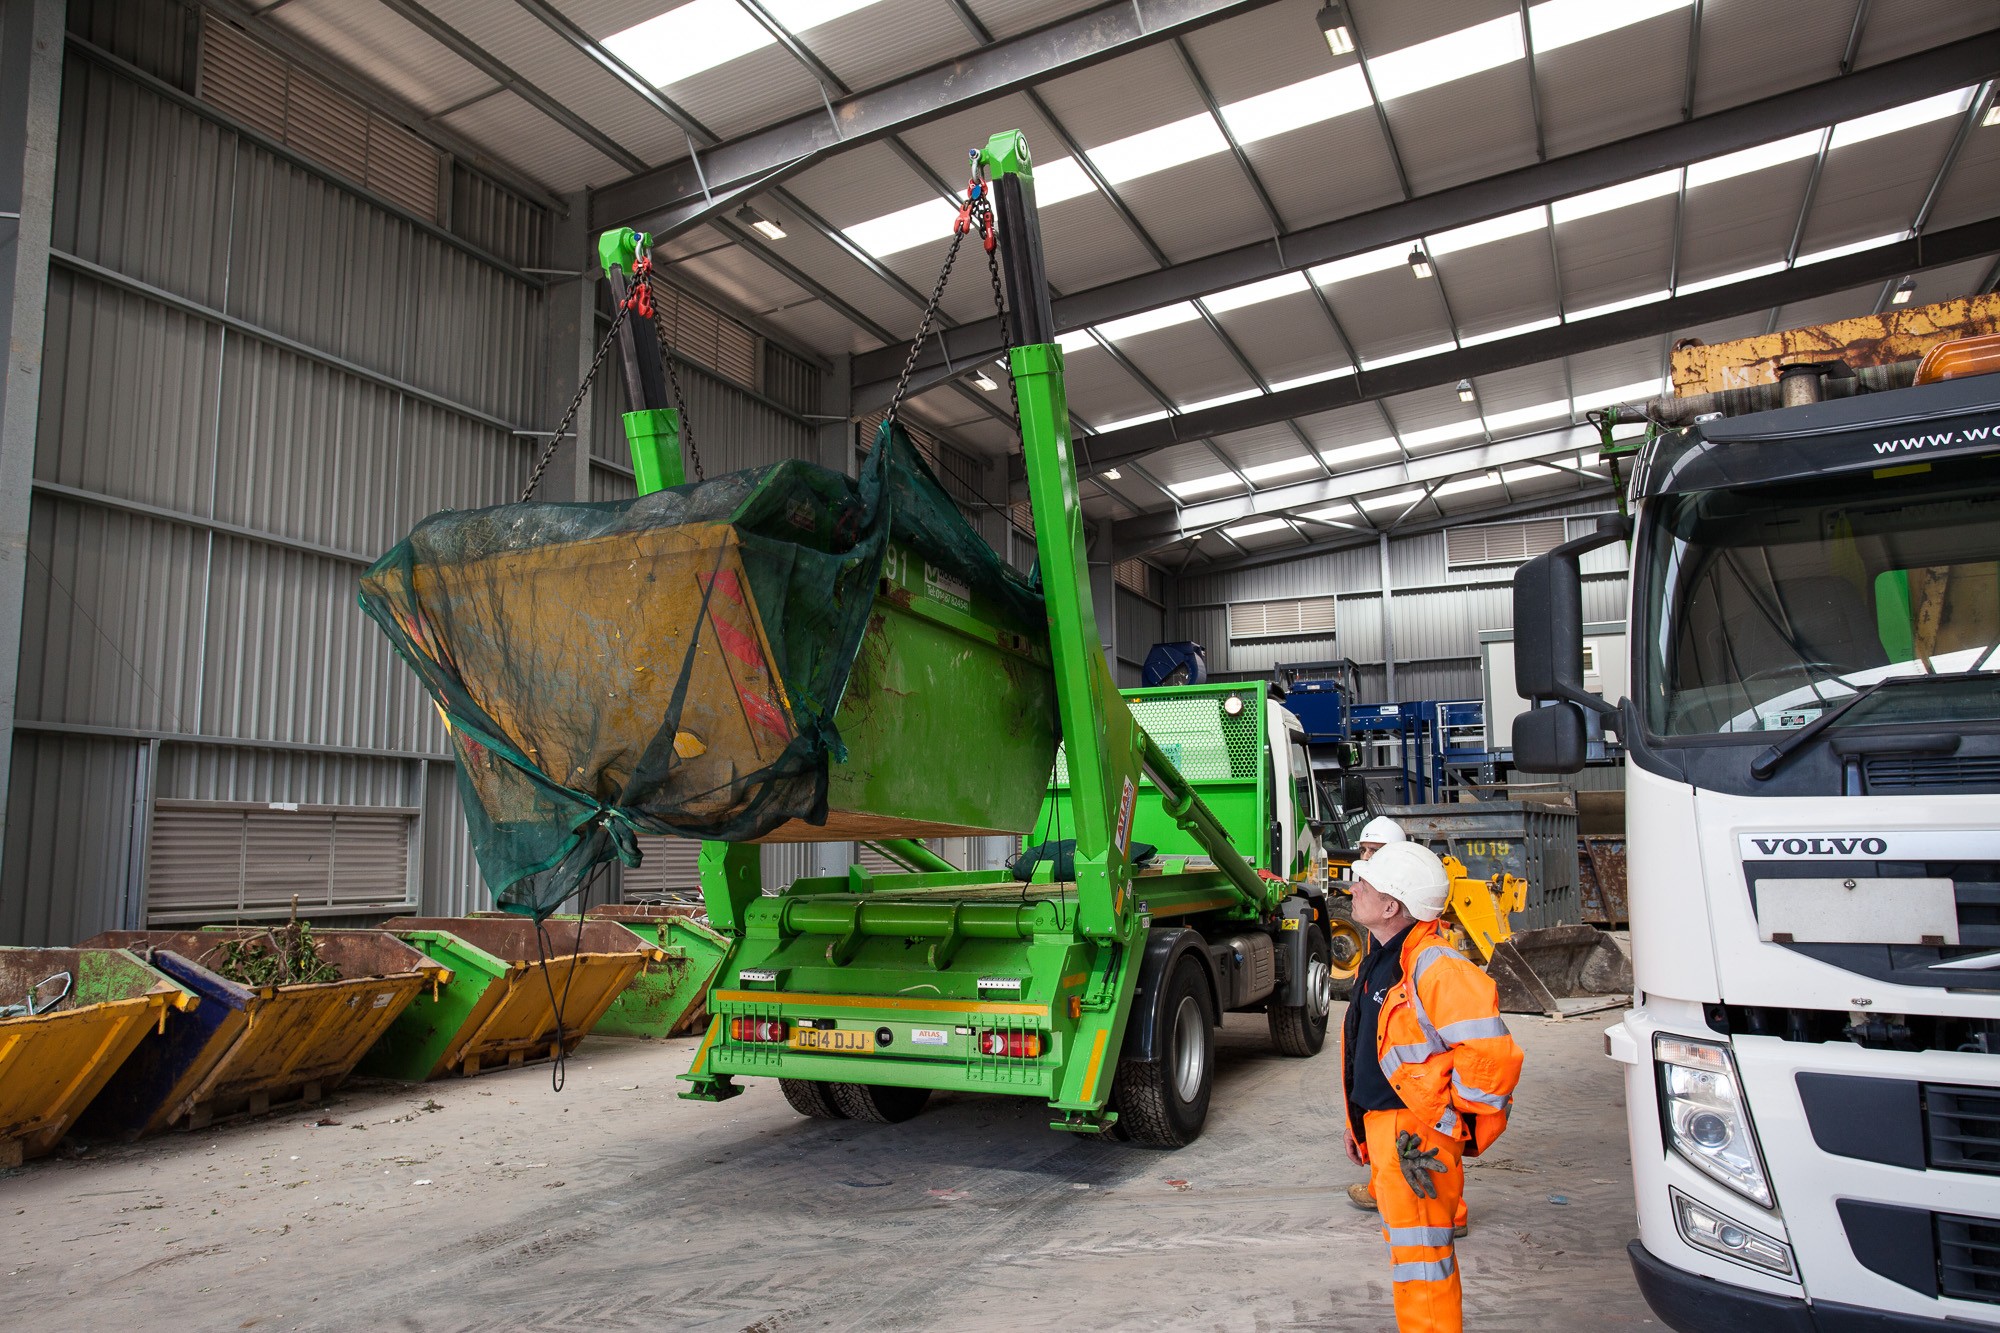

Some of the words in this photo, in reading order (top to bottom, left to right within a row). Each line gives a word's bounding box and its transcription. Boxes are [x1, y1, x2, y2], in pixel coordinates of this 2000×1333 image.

[1118, 784, 1129, 839] ATLAS
[1466, 840, 1509, 856] 1019
[1751, 838, 1887, 855] VOLVO
[799, 1030, 830, 1048] DG14
[835, 1033, 864, 1050] DJJ
